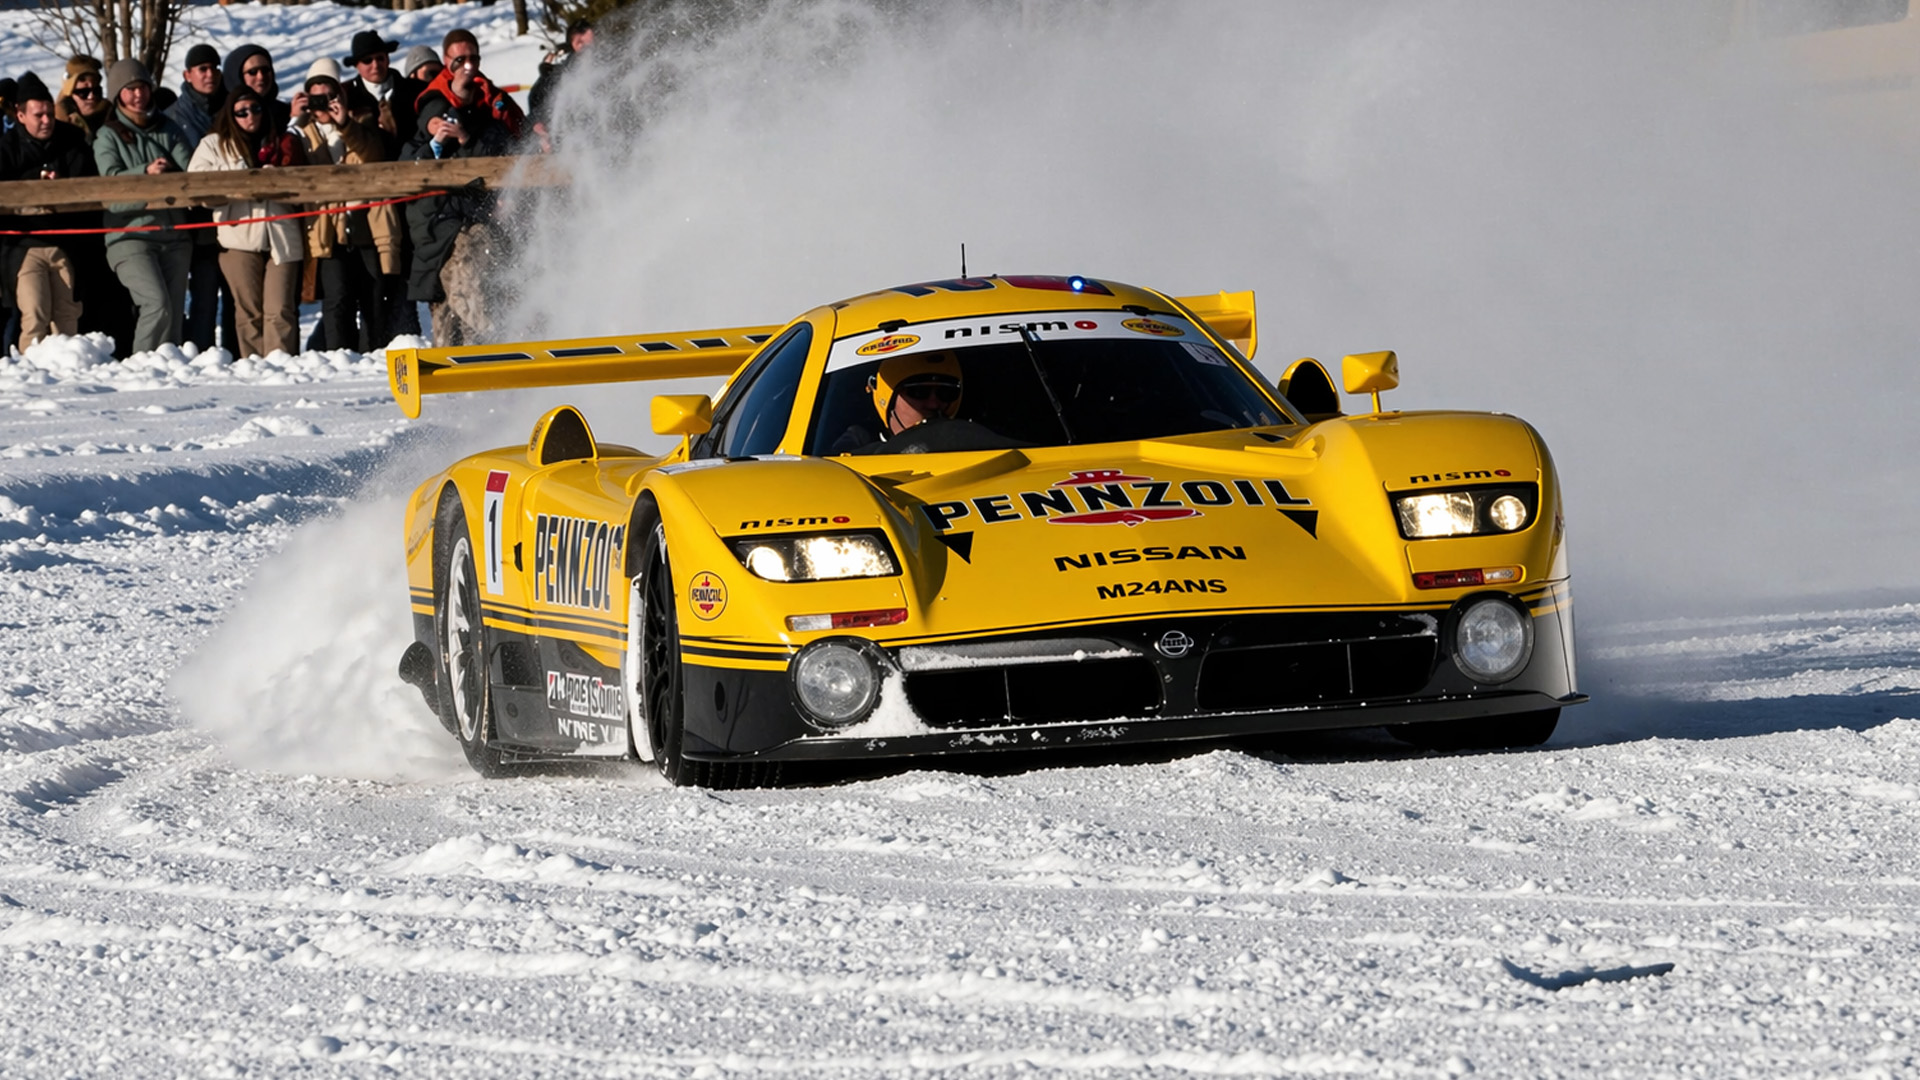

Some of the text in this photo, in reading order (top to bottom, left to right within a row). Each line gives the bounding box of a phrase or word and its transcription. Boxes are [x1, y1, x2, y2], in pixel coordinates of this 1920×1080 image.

[945, 321, 1097, 339] nismo
[1410, 469, 1511, 484] nismo
[921, 479, 1311, 531] PENNZOIL
[740, 516, 850, 530] nismo
[489, 500, 497, 583] 1
[1054, 546, 1247, 571] NISSAN
[1096, 579, 1227, 599] M24ANS
